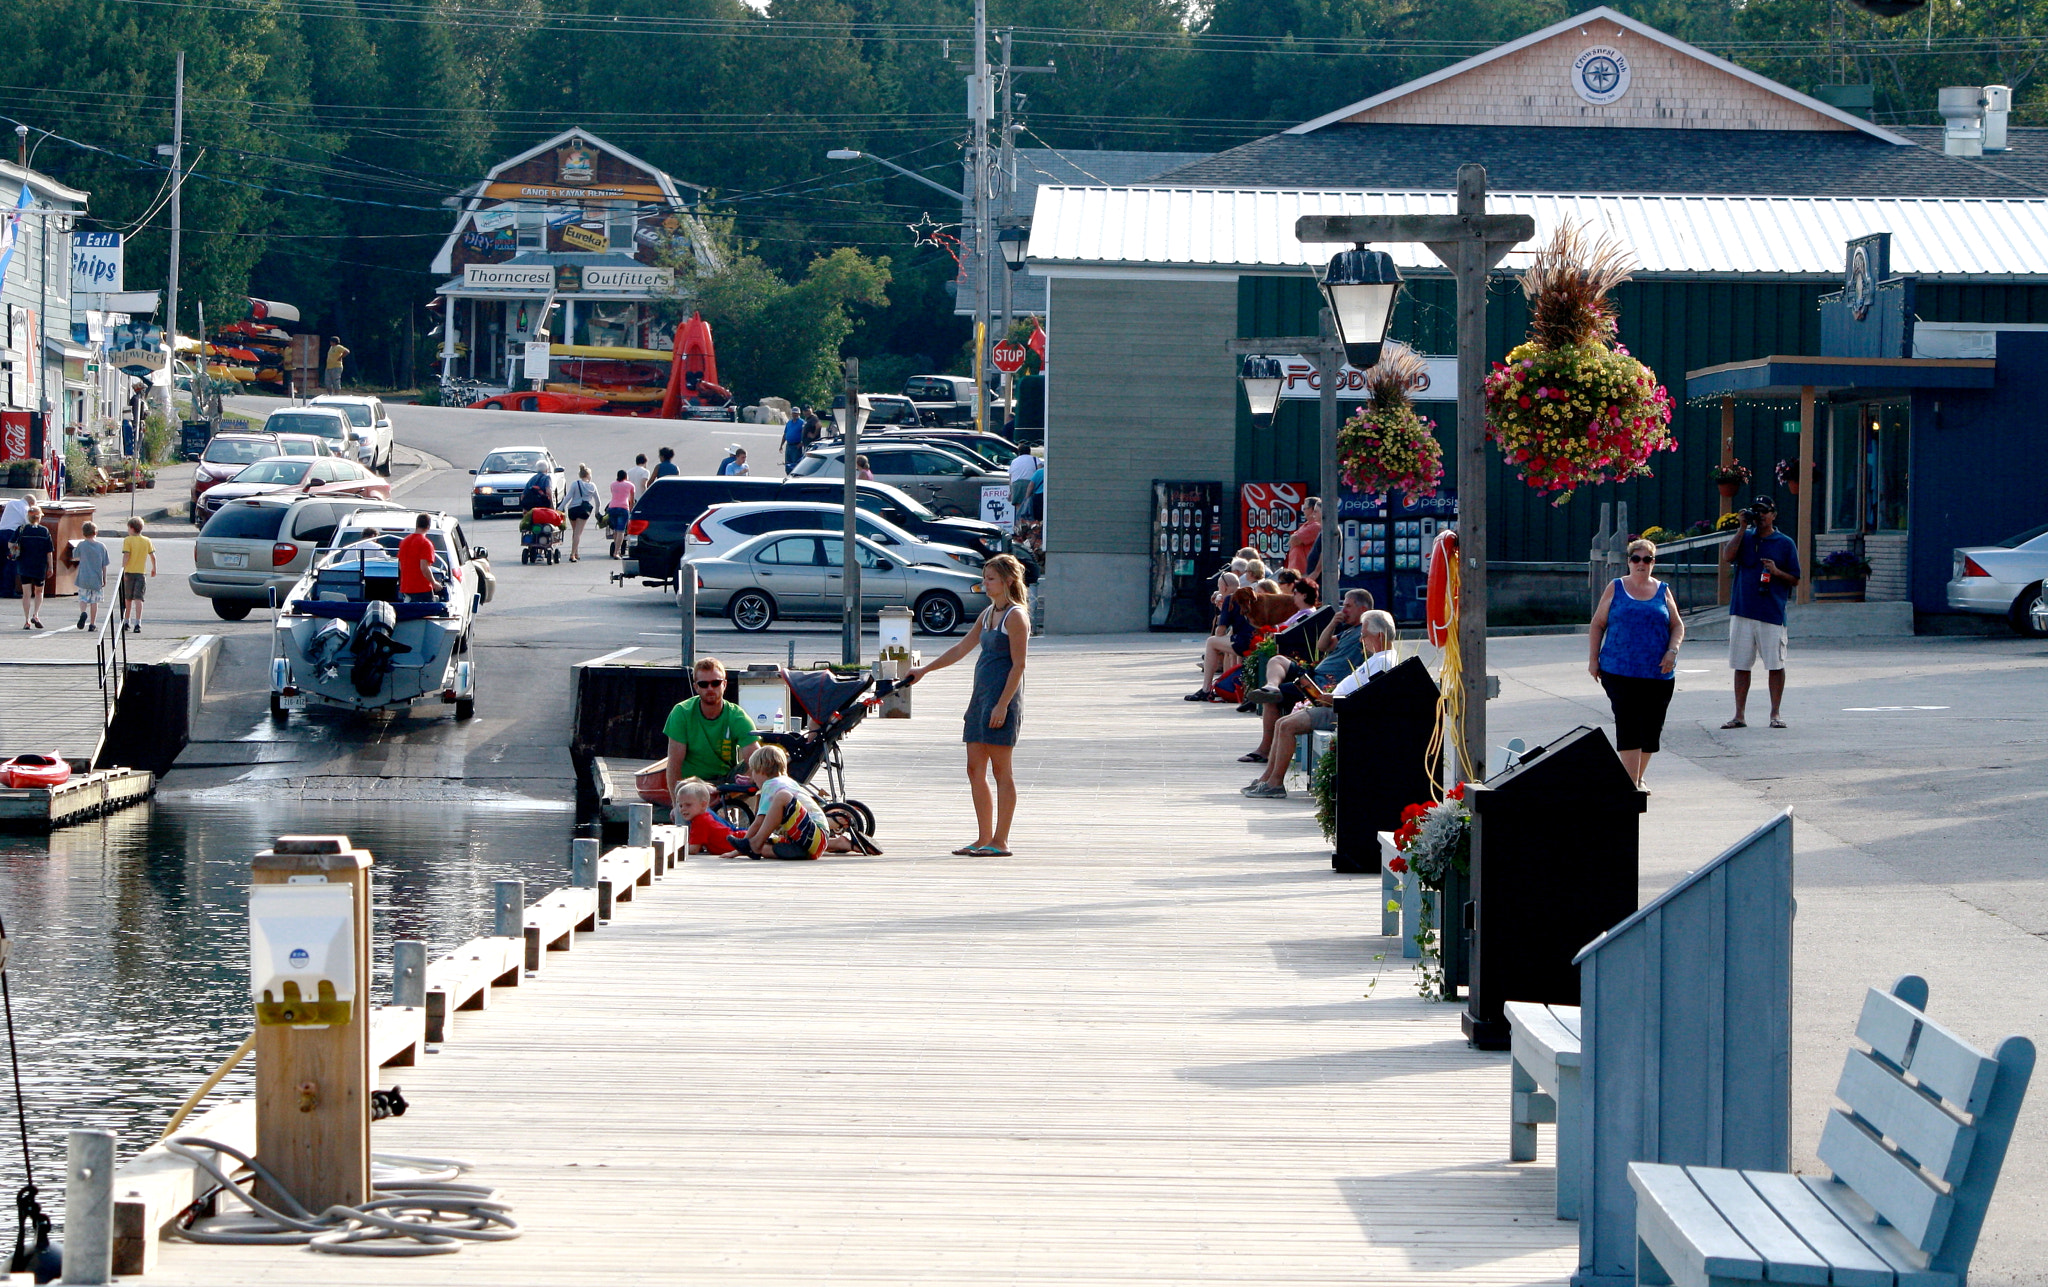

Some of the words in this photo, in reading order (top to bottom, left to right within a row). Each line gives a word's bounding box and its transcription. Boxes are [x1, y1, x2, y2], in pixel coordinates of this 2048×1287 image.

[1575, 48, 1615, 69] Crowsnest
[1616, 56, 1628, 73] Pub
[521, 187, 549, 196] CANOE
[551, 189, 557, 197] &
[560, 189, 586, 197] KAYAK
[86, 233, 114, 246] Eat!
[565, 226, 608, 248] Eureka!
[73, 252, 117, 285] hips
[469, 269, 551, 284] Thorncrest
[587, 271, 669, 287] Outfitters
[995, 349, 1024, 362] STOP
[1785, 422, 1796, 432] 11
[983, 490, 1009, 498] AFRIC
[1345, 500, 1379, 511] pepsi
[1420, 496, 1455, 508] pepsi
